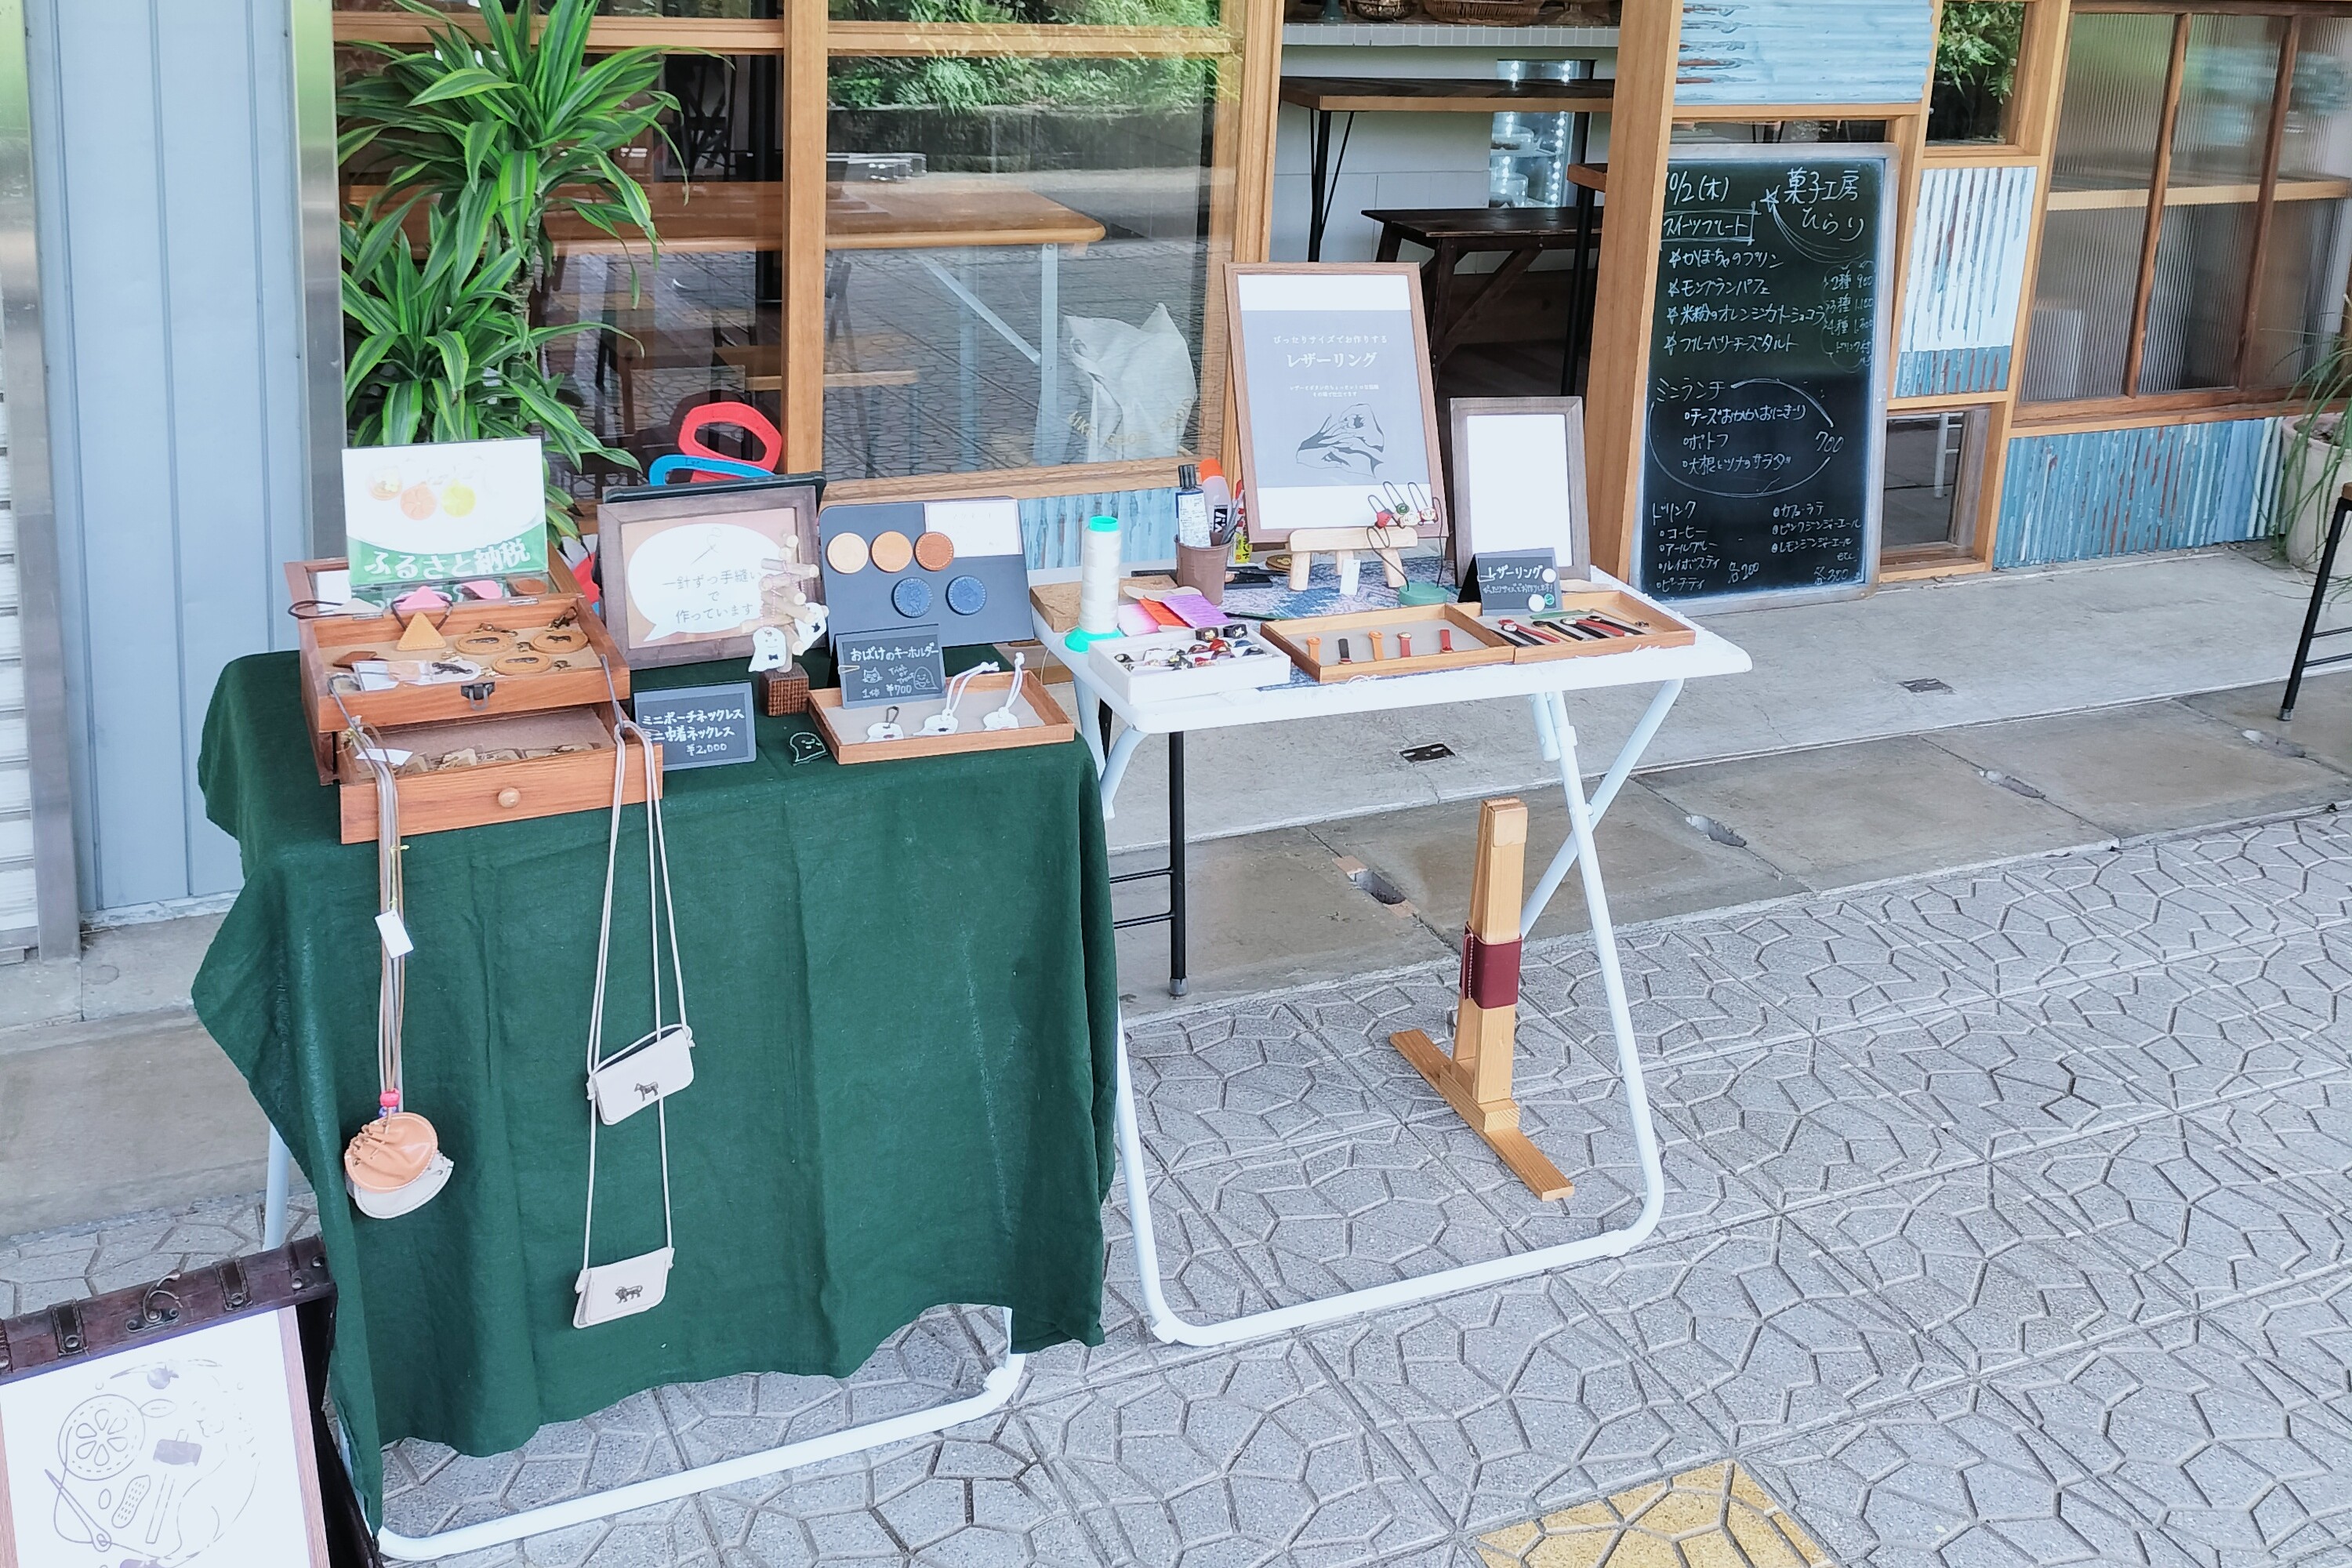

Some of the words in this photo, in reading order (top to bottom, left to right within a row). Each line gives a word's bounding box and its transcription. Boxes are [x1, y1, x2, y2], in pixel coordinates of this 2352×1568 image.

[1784, 166, 1860, 205] 菓子工房
[1663, 214, 1748, 236] スイーツプレート
[1802, 206, 1864, 241] ひらり
[1682, 278, 1770, 296] モンブランパフェ
[1287, 351, 1377, 368] レザーリング
[1656, 377, 1725, 402] ミニランチ
[1815, 431, 1844, 452] 700
[1652, 500, 1697, 526] ドリンク
[1667, 524, 1708, 539] コーヒー
[364, 538, 532, 580] ふるさと納税
[662, 568, 762, 590] 一針ずつ手縫い
[708, 590, 720, 602] で
[675, 603, 753, 624] 作っています
[850, 641, 939, 662] おばけのキーホルダー
[641, 708, 745, 725] ミニポーチネックレス
